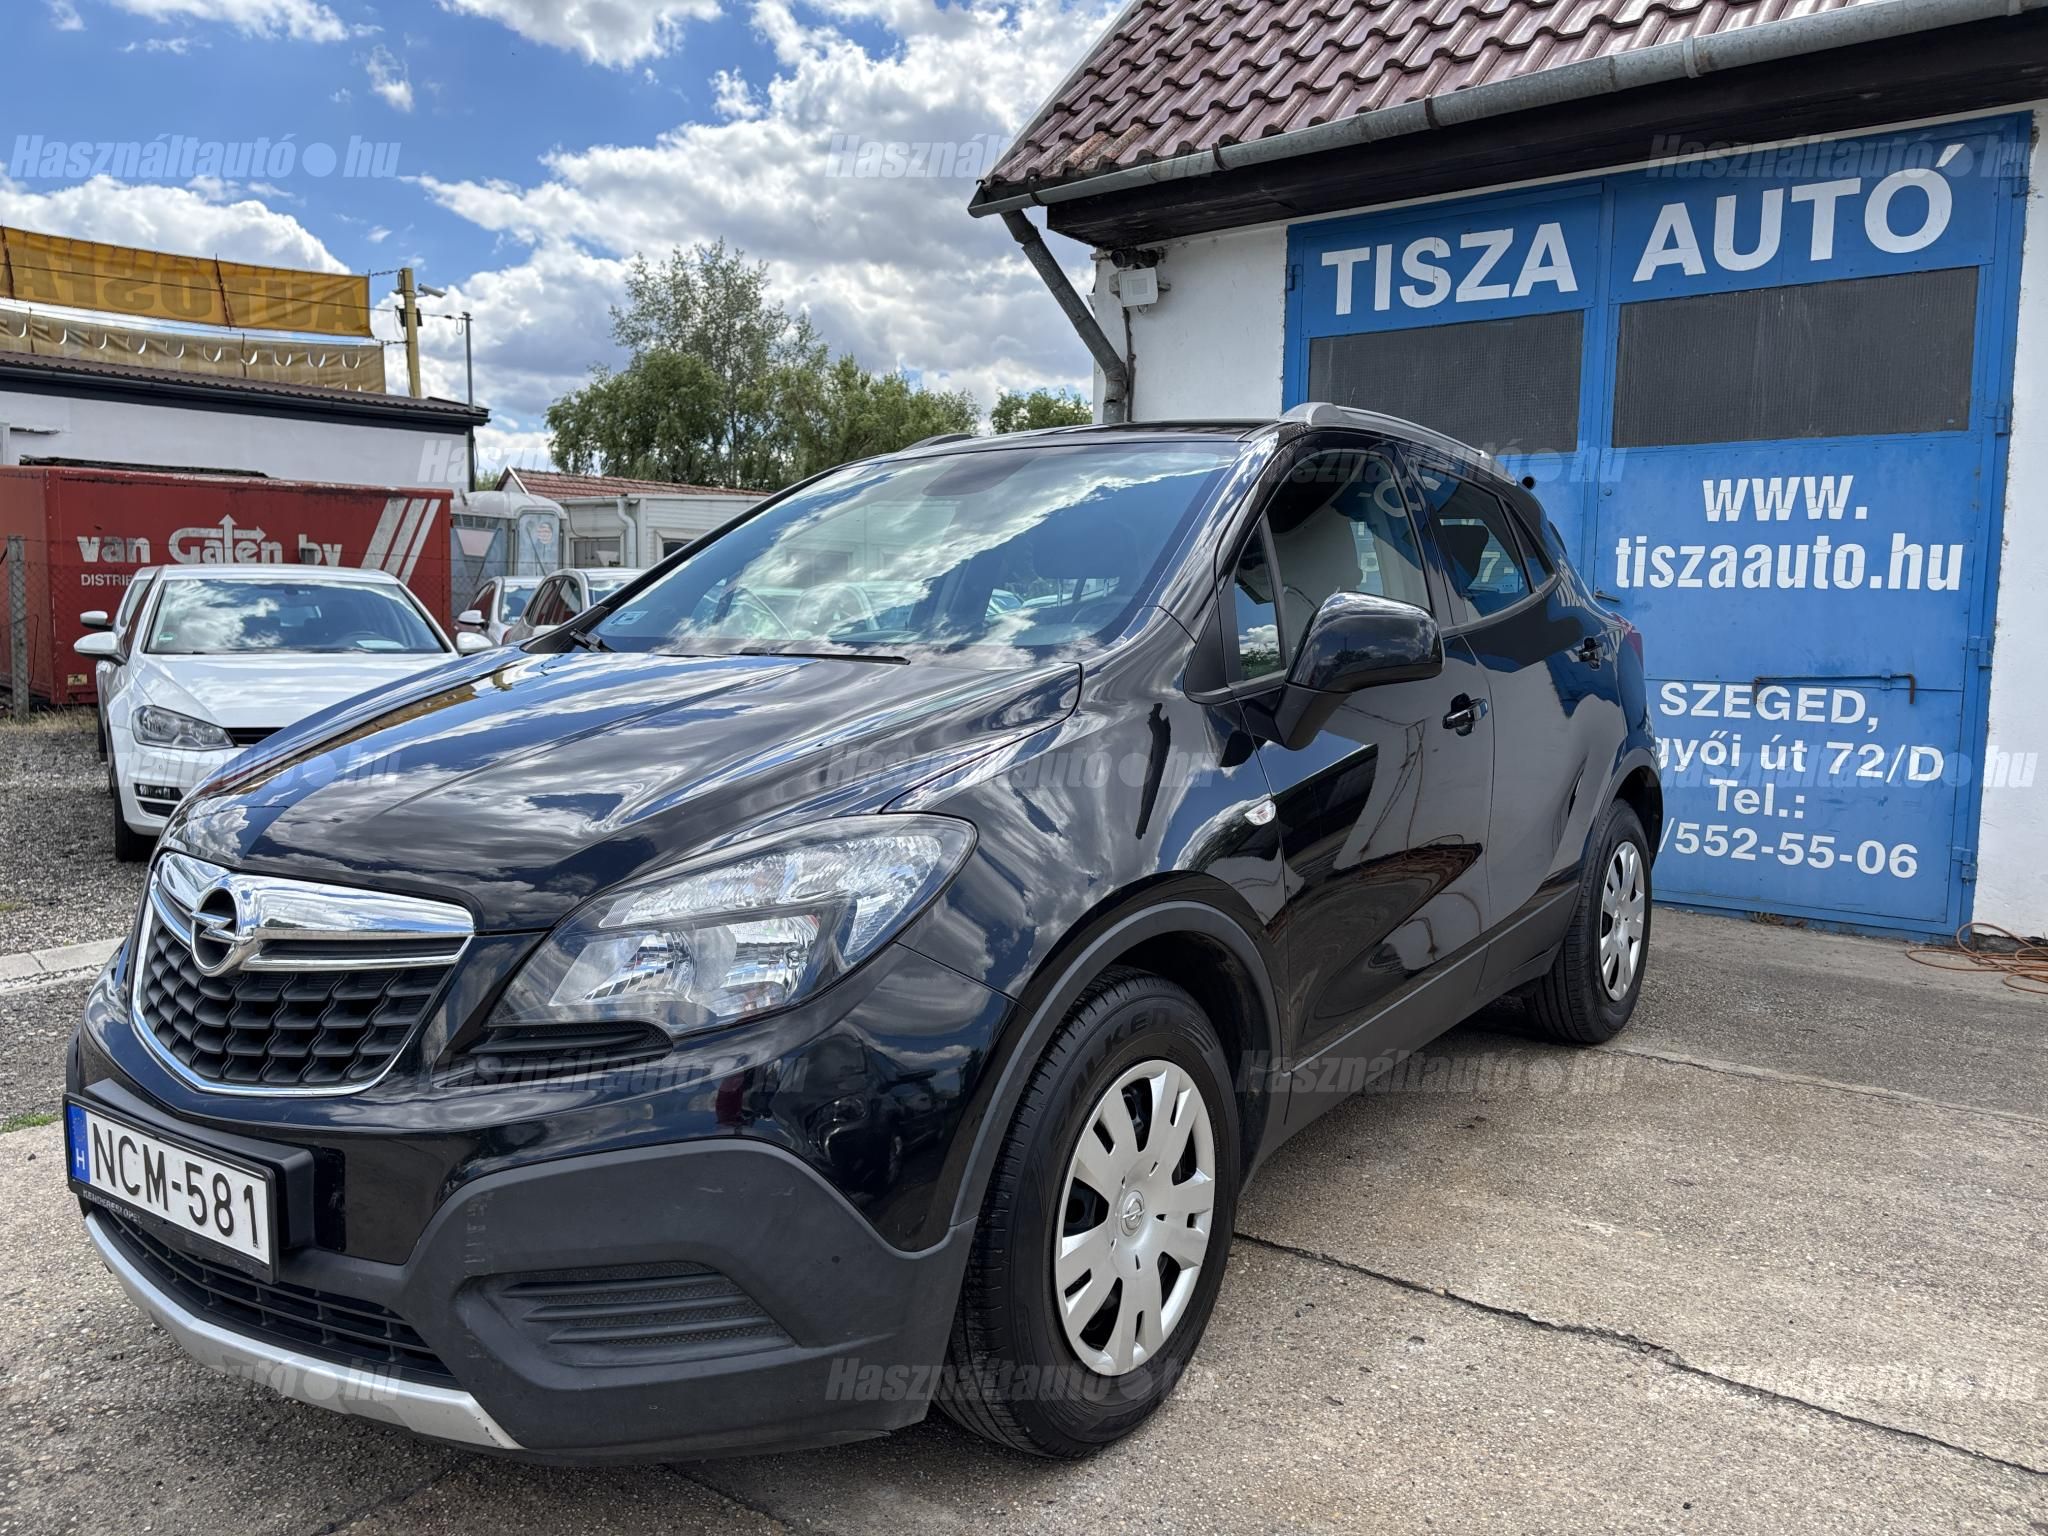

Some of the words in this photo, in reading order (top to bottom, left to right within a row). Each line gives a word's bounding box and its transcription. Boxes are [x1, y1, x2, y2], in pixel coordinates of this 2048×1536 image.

[1321, 222, 1578, 315] TISZA
[1633, 143, 1953, 282] AUTÓ
[1702, 475, 1867, 522] www.
[77, 536, 150, 563] van
[1616, 532, 1963, 591] tiszaauto.hu
[1659, 682, 1879, 734] SZEGED,
[1655, 730, 1742, 772] győi
[1760, 734, 1808, 773] út
[1826, 741, 1944, 783] 72/D
[1710, 778, 1805, 819] Tel.:
[1658, 817, 1918, 879] /552-55-06
[76, 1148, 86, 1170] H
[93, 1123, 260, 1249] NCM-581
